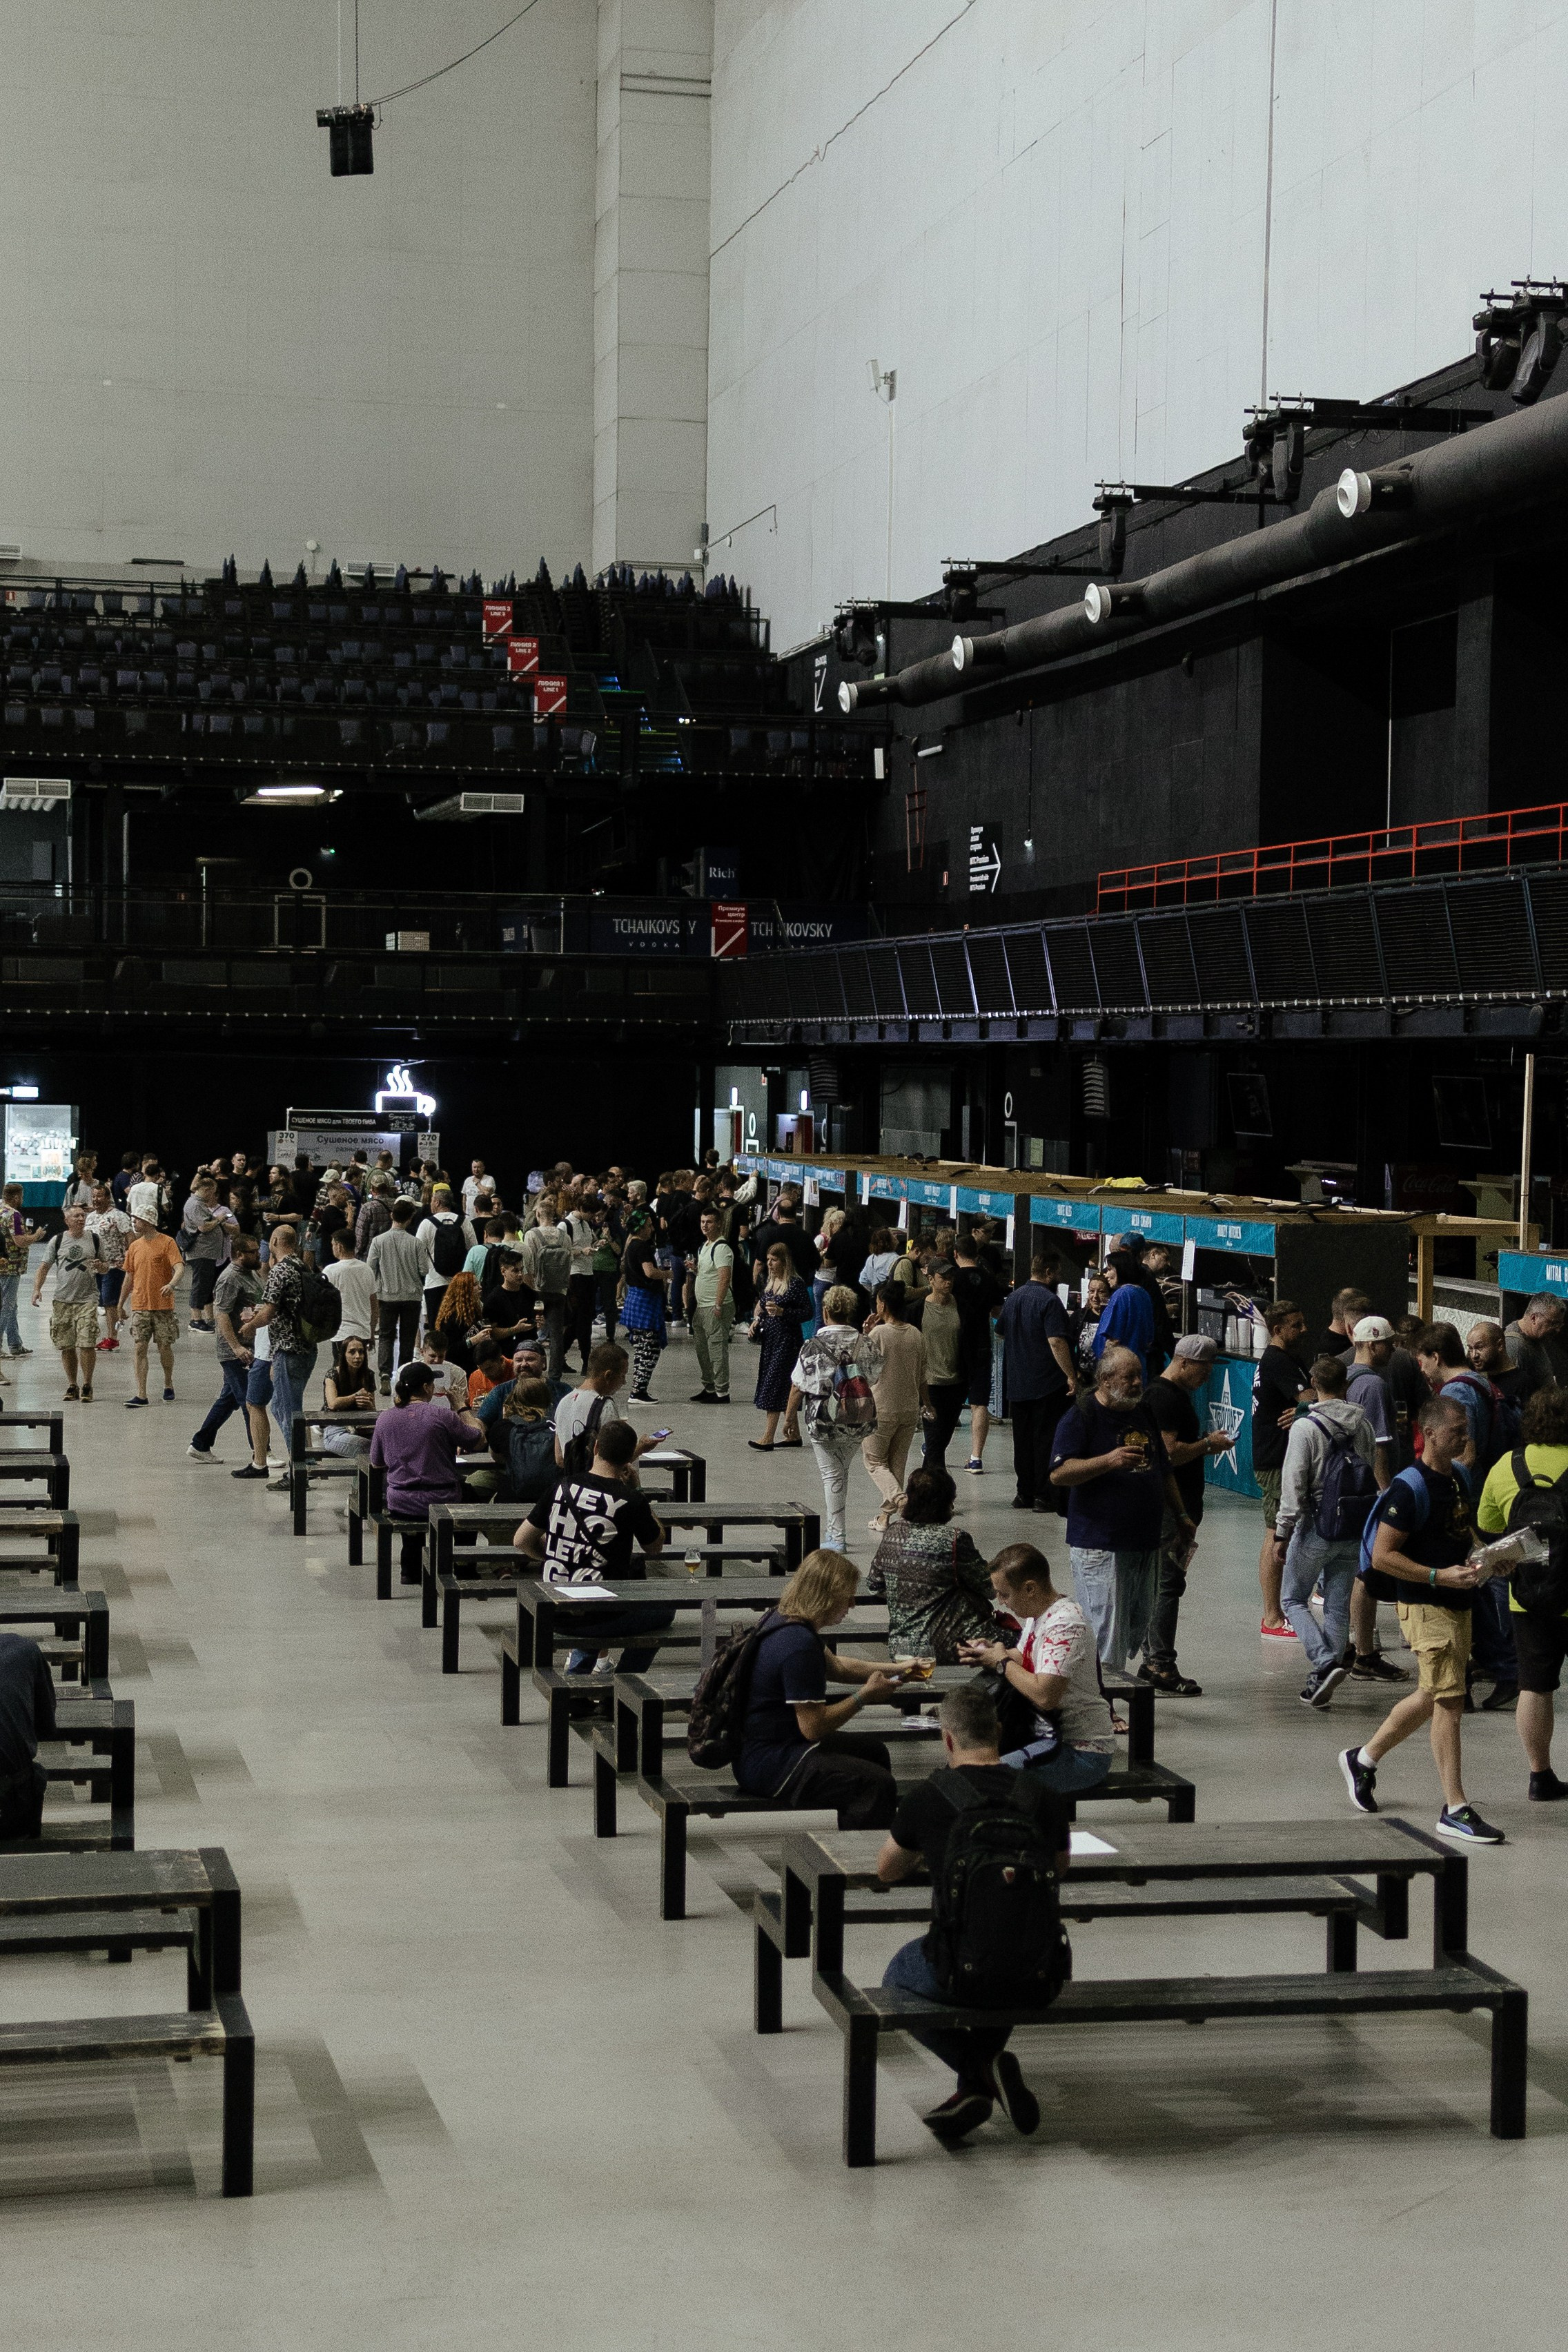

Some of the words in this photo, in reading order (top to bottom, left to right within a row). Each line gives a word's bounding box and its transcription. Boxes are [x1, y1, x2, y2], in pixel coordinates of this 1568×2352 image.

[708, 867, 735, 879] Rich
[612, 919, 697, 934] TCHAIKOVSY
[750, 921, 833, 938] TCHKOVSKY
[317, 1135, 359, 1144] Сушеное
[549, 1502, 618, 1545] HO
[545, 1533, 608, 1567] LET'S
